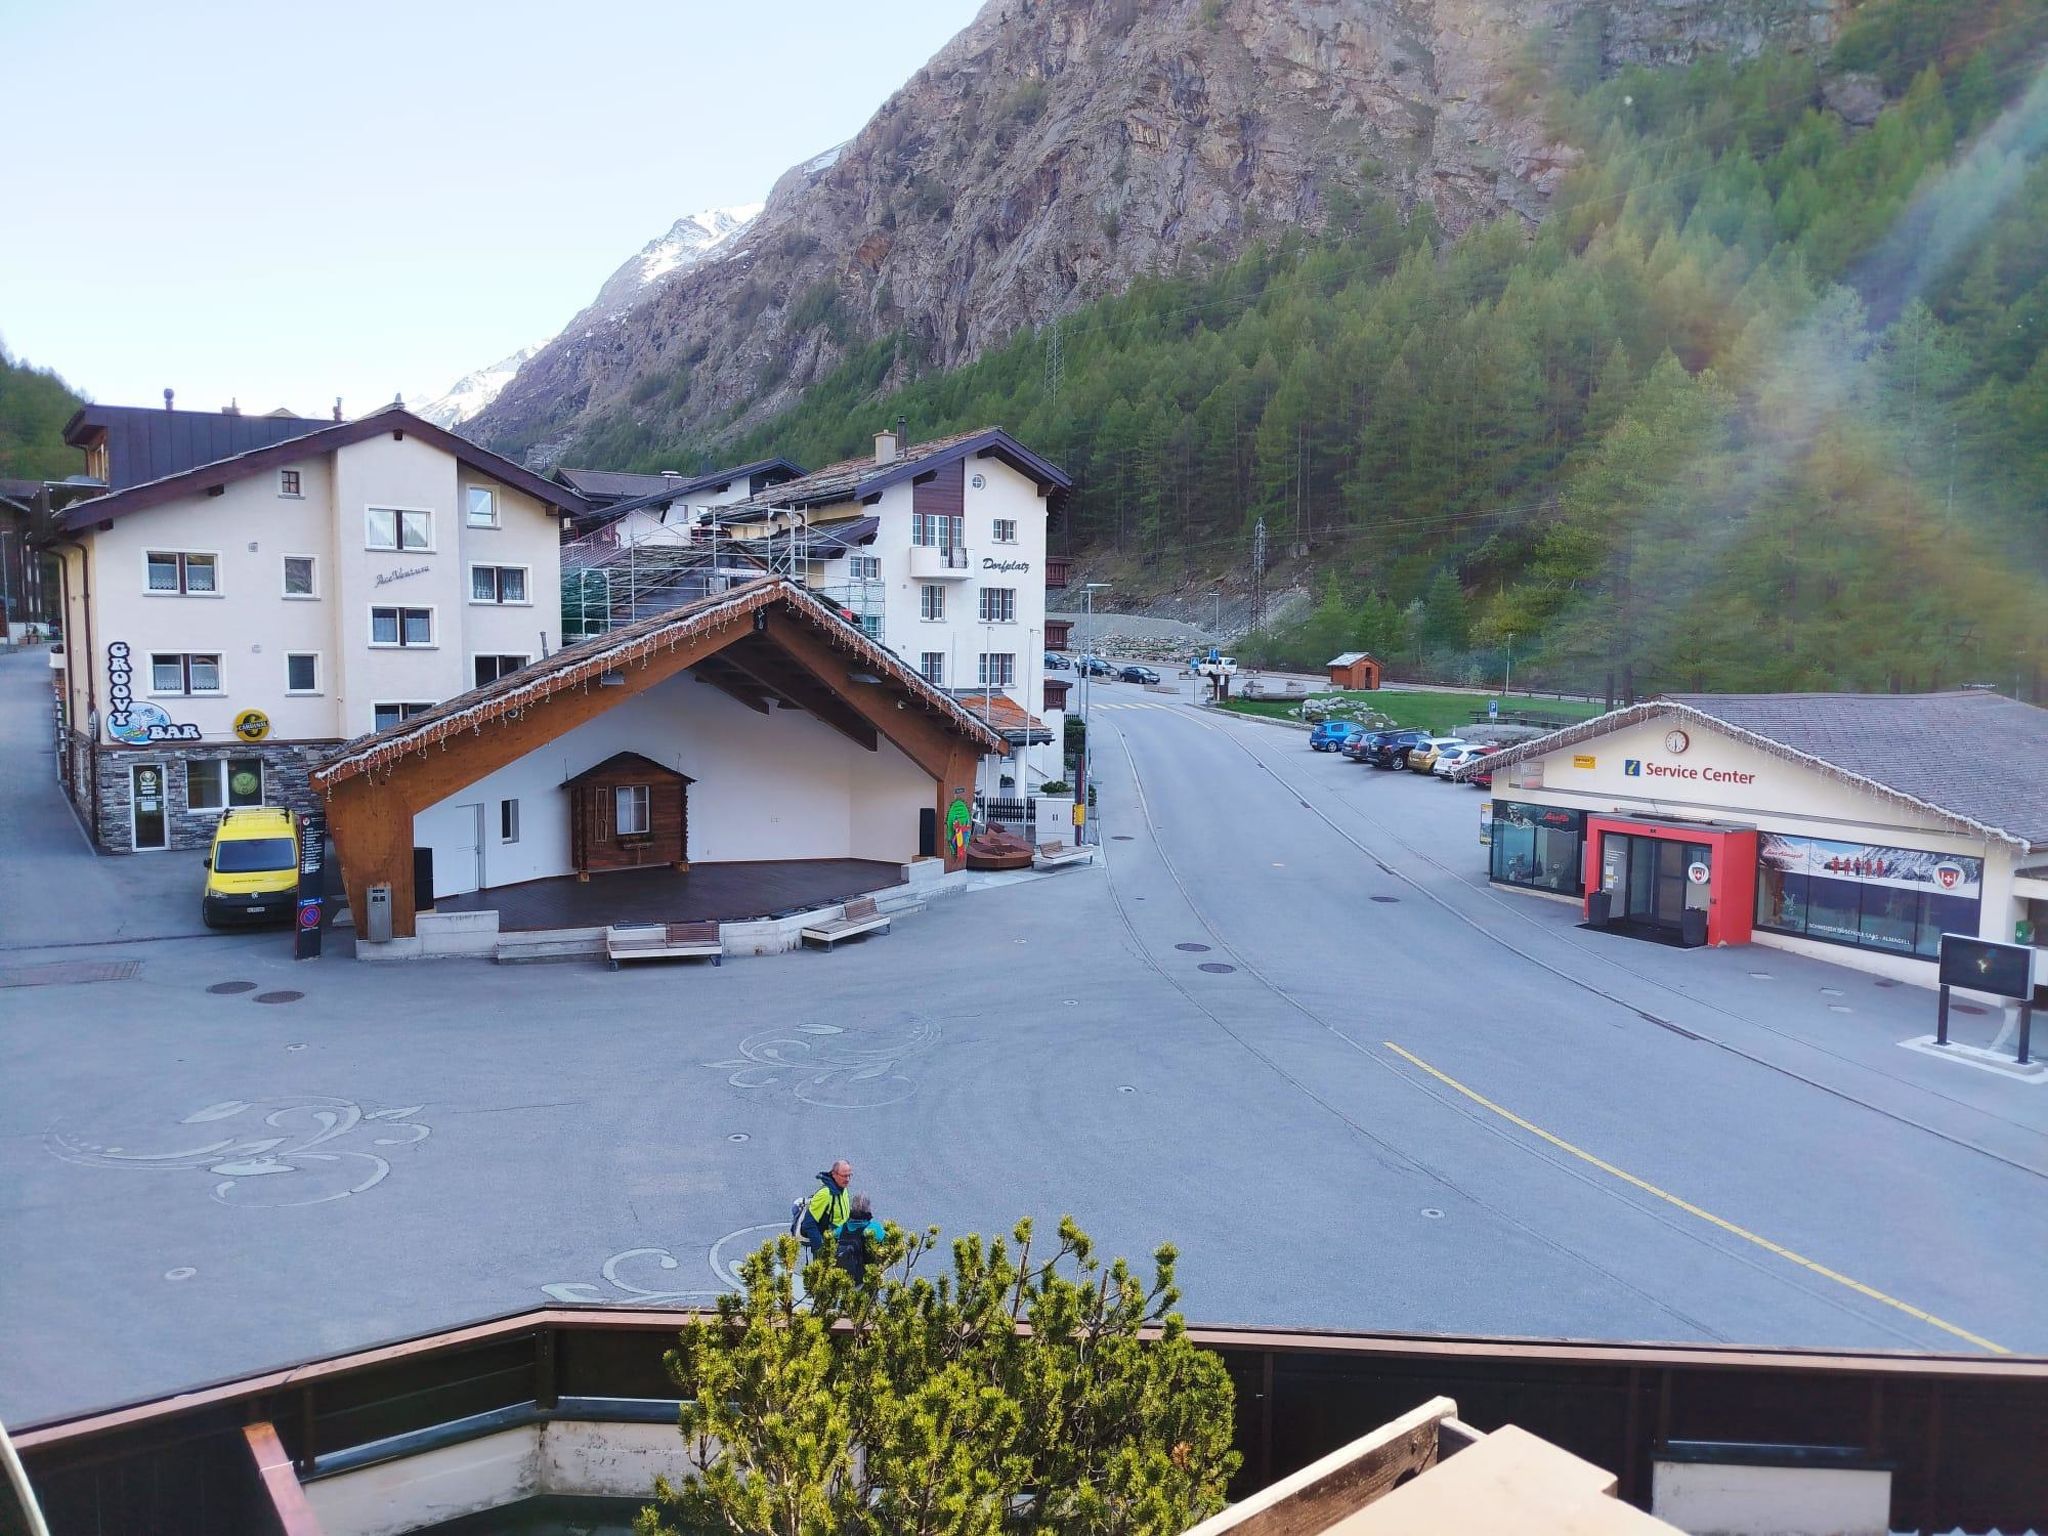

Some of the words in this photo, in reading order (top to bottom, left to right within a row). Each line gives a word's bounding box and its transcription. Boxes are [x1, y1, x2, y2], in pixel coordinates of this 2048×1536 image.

[983, 557, 1030, 574] Dorfplatz
[108, 642, 132, 727] GROOVY
[149, 725, 201, 740] BAR
[237, 721, 268, 732] CARDINAL
[1646, 762, 1697, 780] Service
[1702, 767, 1756, 785] Center
